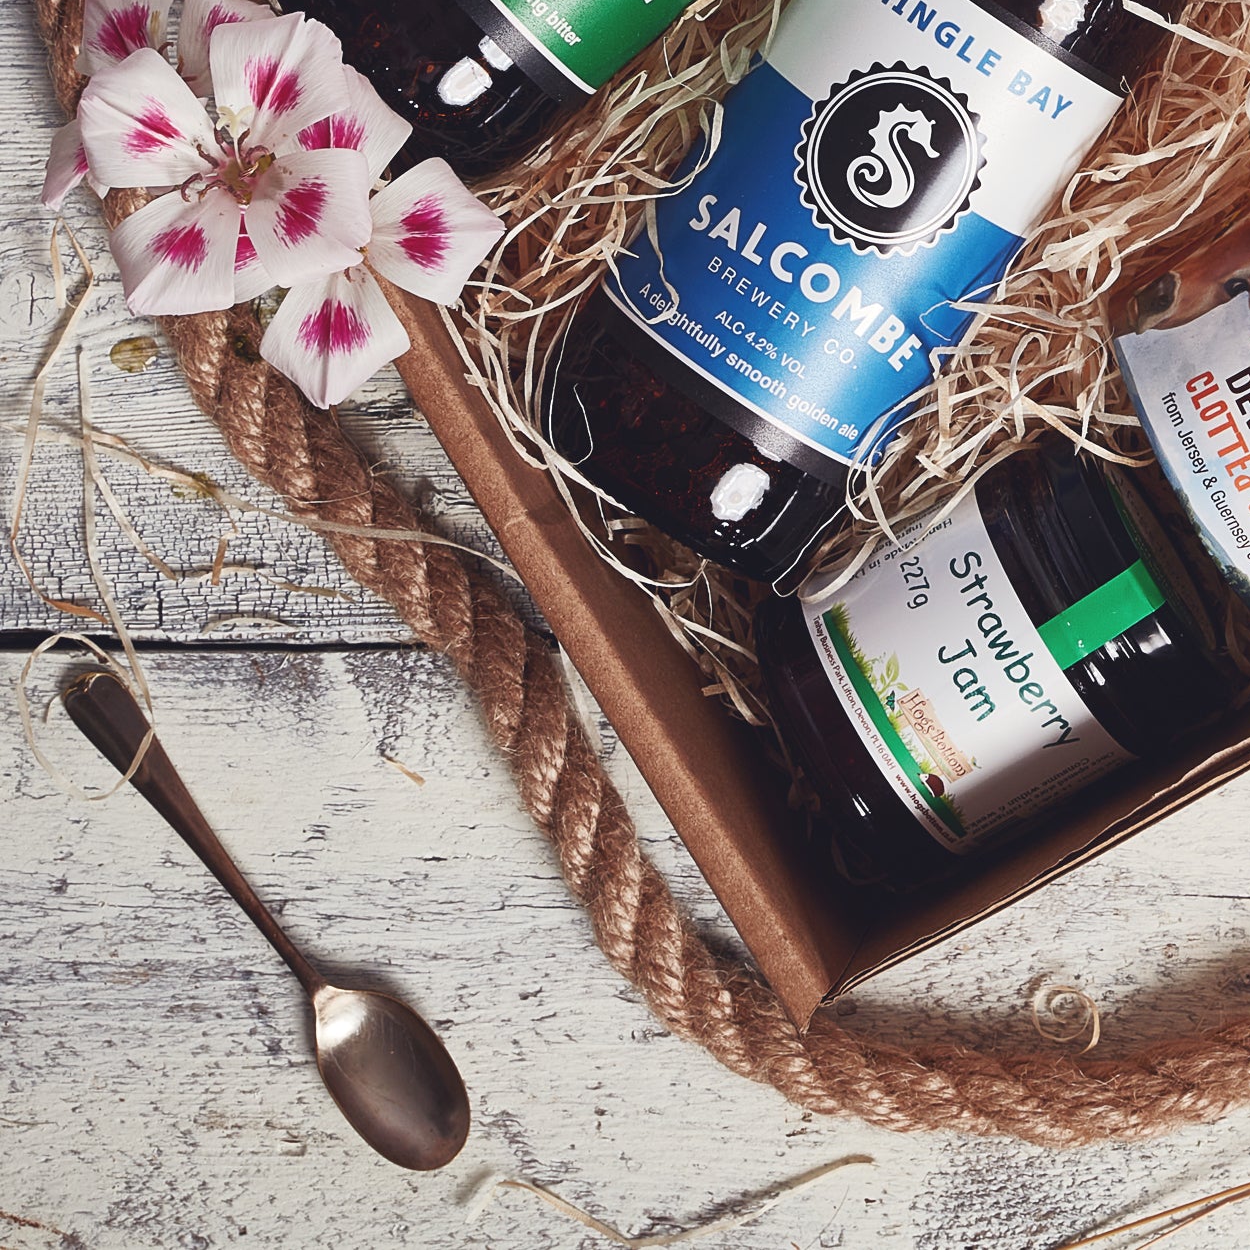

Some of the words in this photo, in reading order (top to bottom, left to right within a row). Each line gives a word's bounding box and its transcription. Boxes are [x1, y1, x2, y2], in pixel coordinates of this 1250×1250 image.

[543, 11, 582, 47] bitter
[1007, 69, 1073, 120] BAY
[689, 194, 922, 372] SALCOMBE
[708, 257, 816, 337] BREWERY
[823, 339, 858, 370] CO.
[639, 283, 652, 298] A
[725, 352, 787, 399] smooth
[786, 393, 839, 431] golden
[837, 419, 860, 441] ale
[715, 310, 745, 336] ALC
[744, 328, 777, 360] 4.2%
[780, 353, 806, 379] VOL
[1161, 392, 1185, 427] from
[1177, 428, 1209, 475] Jersey
[1203, 477, 1218, 490] &
[900, 556, 930, 610] 227g
[820, 635, 836, 667] Business
[833, 665, 845, 685] Park,
[841, 683, 857, 709] Lifton,
[854, 707, 872, 736] Devon,
[938, 638, 997, 722] Jam
[949, 550, 1081, 749] Strawberry
[931, 730, 966, 777] Bottom
[1042, 757, 1090, 788] Consume
[1007, 786, 1040, 807] within
